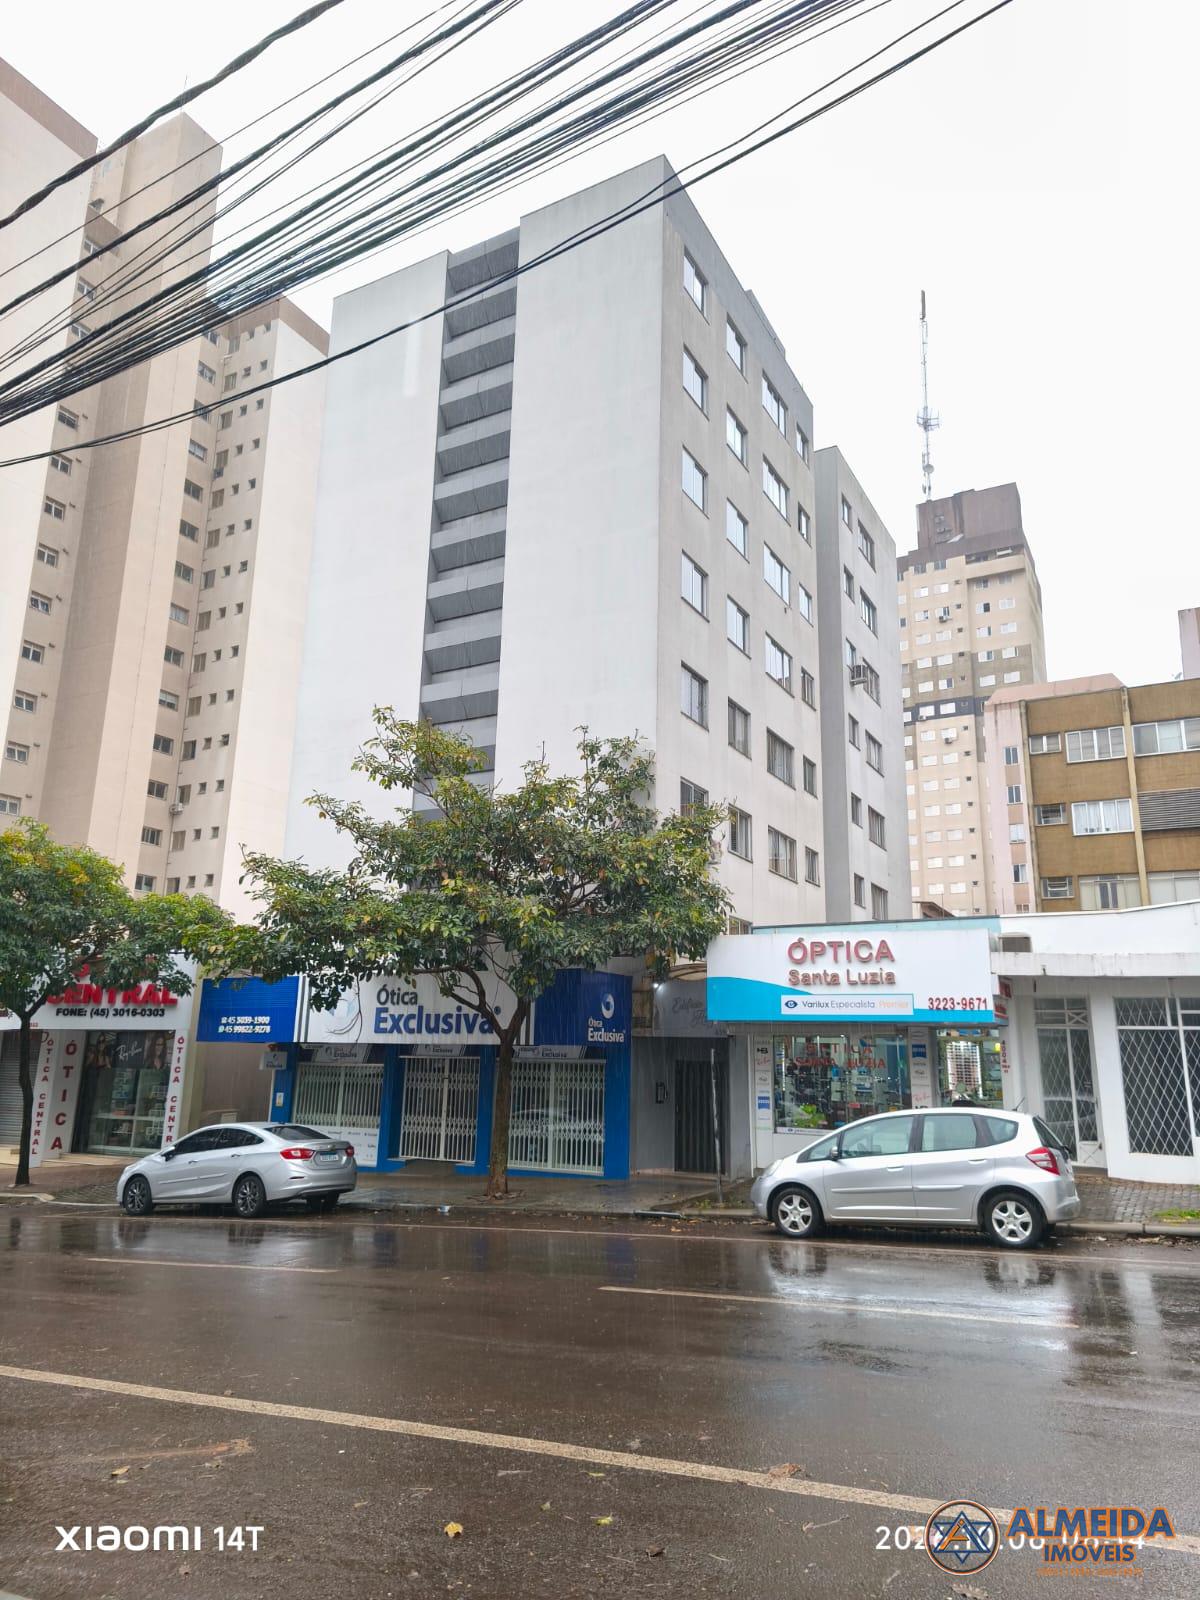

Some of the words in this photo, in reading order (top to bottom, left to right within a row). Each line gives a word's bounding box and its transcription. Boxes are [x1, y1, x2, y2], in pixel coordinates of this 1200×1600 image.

[787, 937, 895, 964] ÓPTICA
[788, 969, 841, 986] Santa
[846, 967, 896, 986] Luzia
[377, 983, 418, 1006] Ótica
[801, 999, 829, 1009] Varilux
[830, 999, 875, 1010] Especialista
[927, 997, 988, 1011] 3223-9671
[55, 1007, 87, 1017] FONE:
[90, 1007, 110, 1018] (45)
[112, 1007, 166, 1017] 3016-0303
[373, 1005, 494, 1035] Exclusiva
[587, 1027, 625, 1043] Exclusiva
[172, 1035, 185, 1083] ÓTICA
[31, 1093, 47, 1155] CENTRAL
[165, 1095, 178, 1143] CENTR
